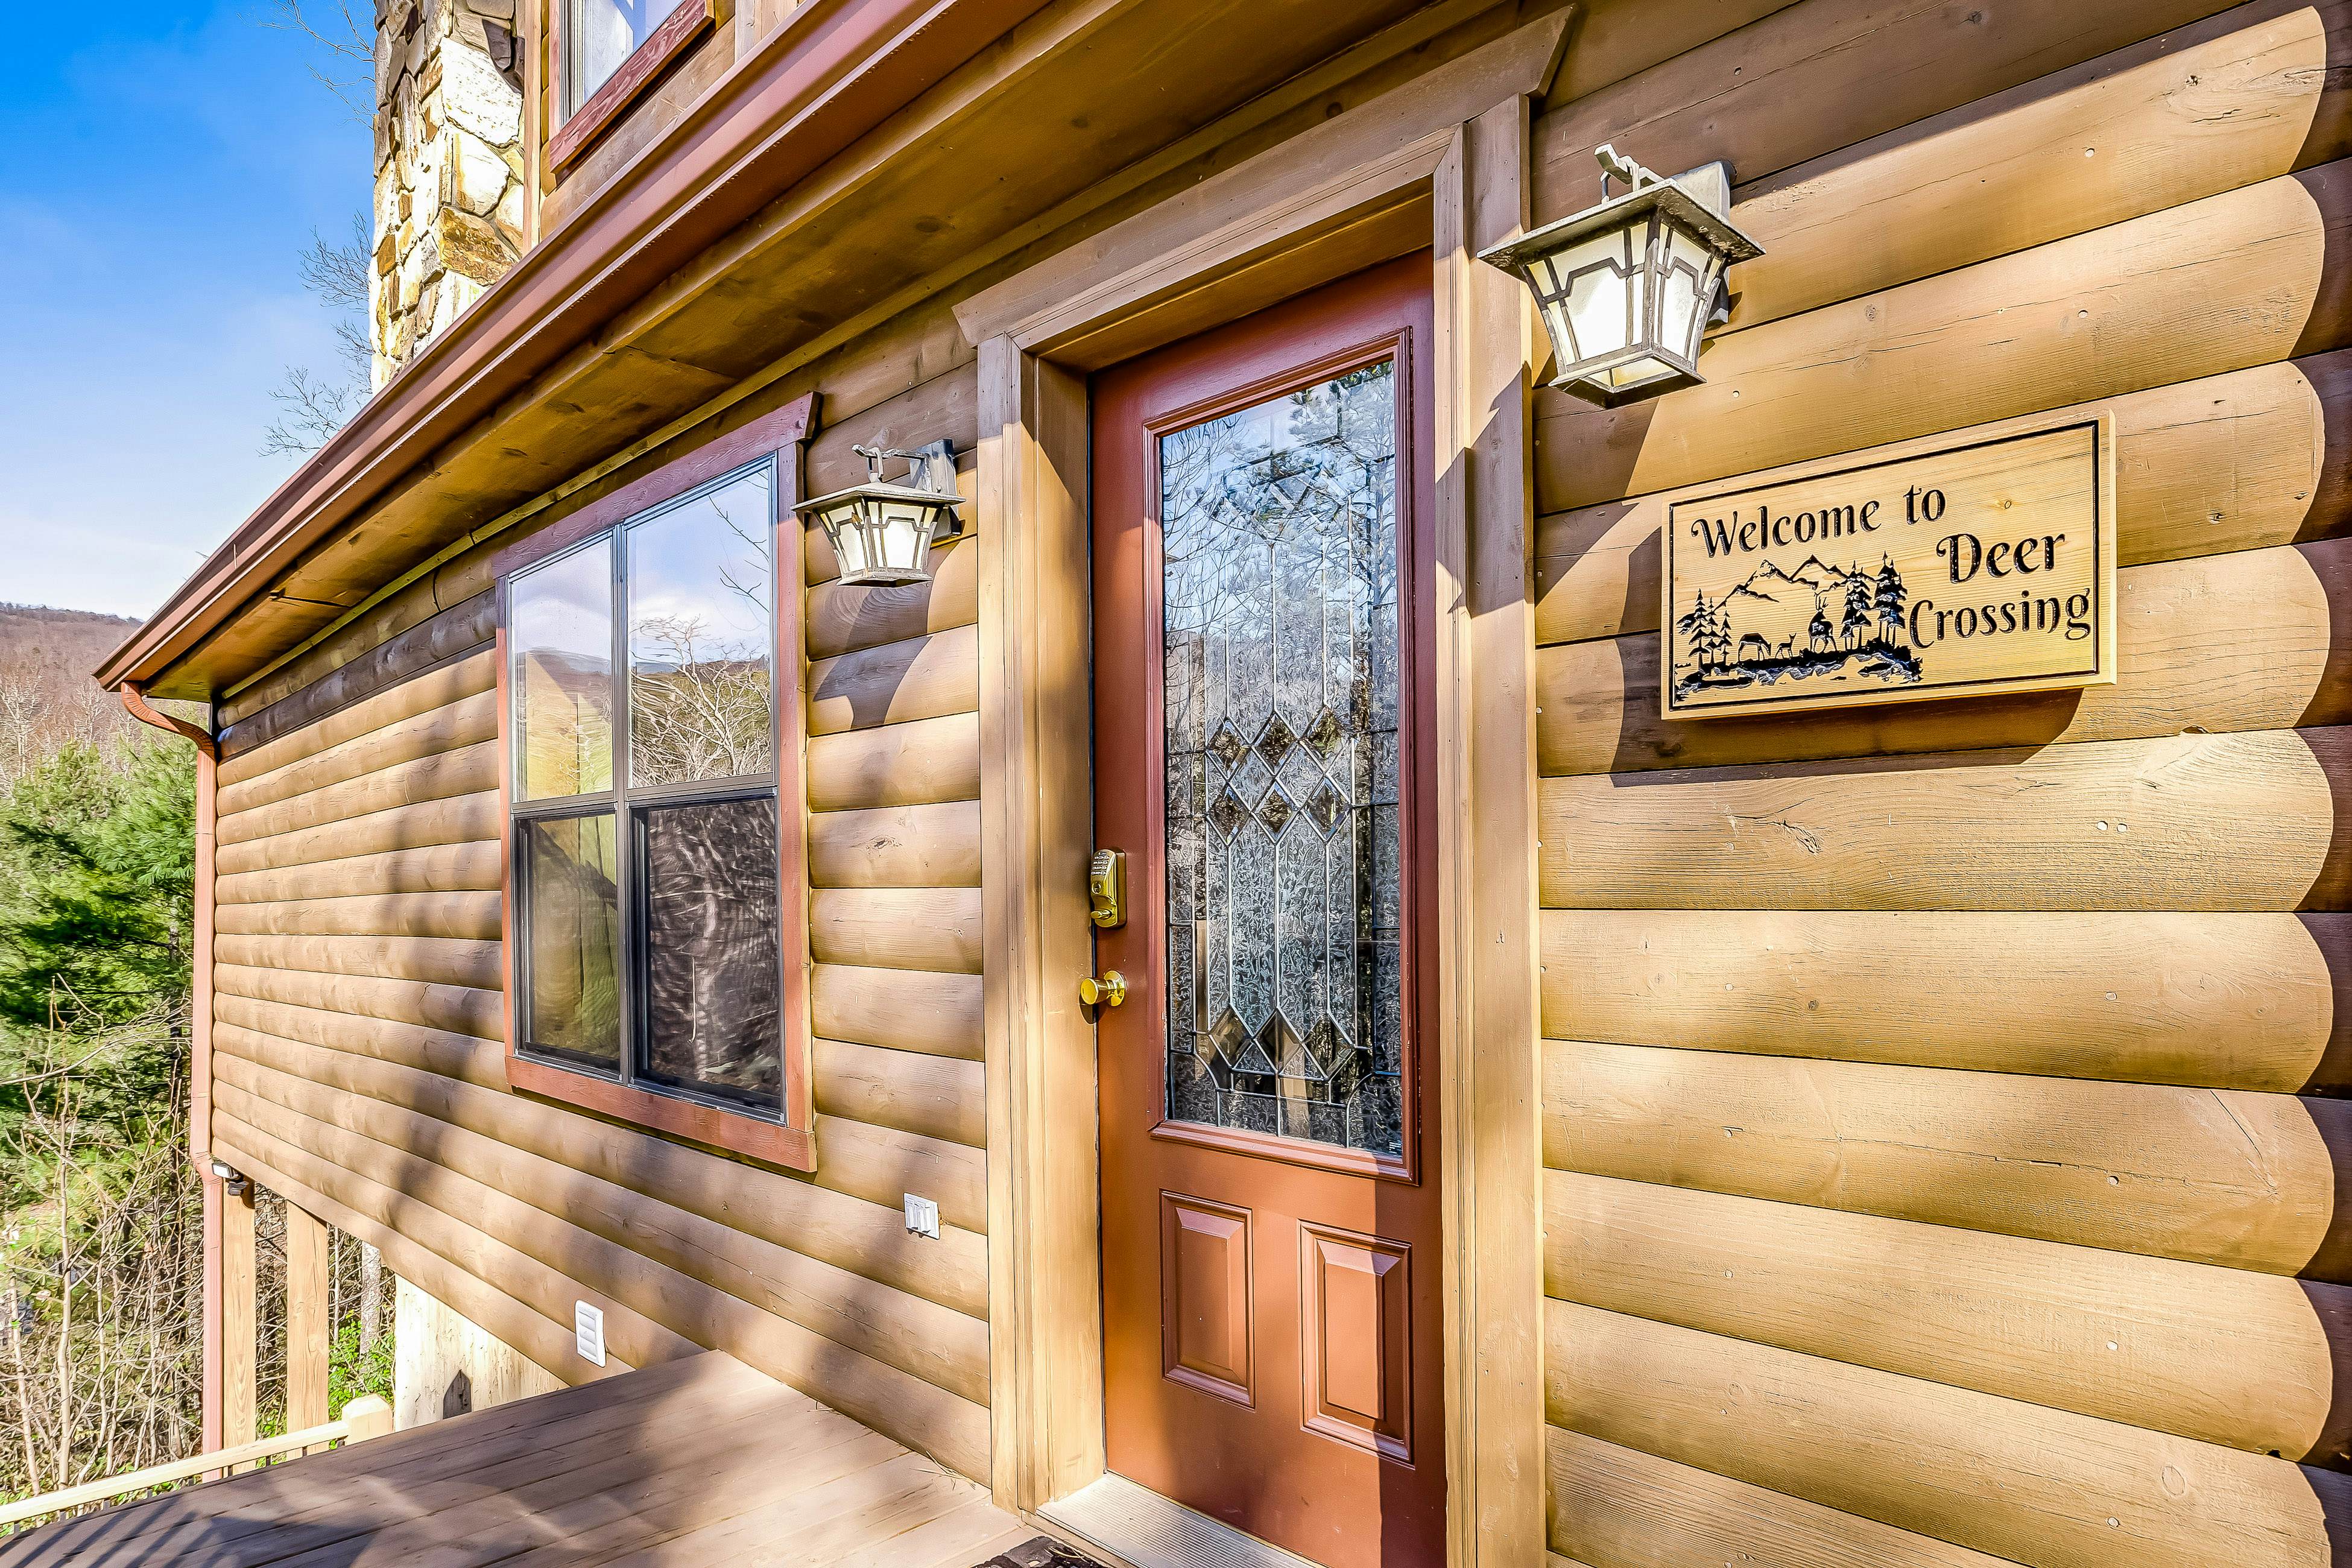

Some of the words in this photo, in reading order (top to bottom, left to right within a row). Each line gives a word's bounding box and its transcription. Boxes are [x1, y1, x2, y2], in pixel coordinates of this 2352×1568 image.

[1691, 500, 1881, 558] Welcome
[1904, 484, 1946, 524] to
[1936, 533, 2065, 584] Deer
[1910, 587, 2091, 648] Crossing
